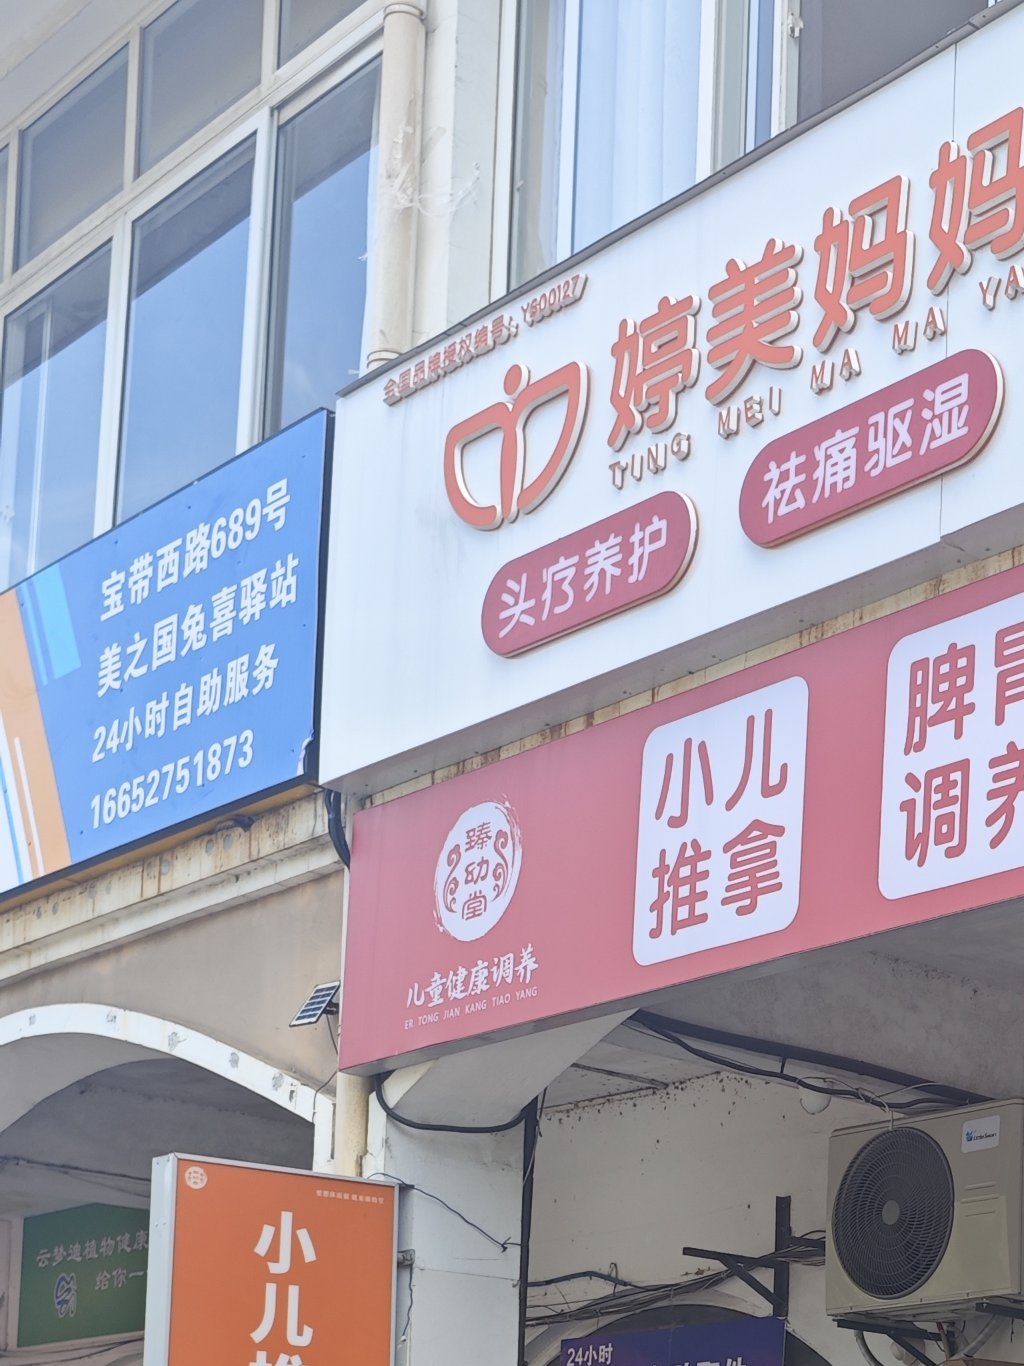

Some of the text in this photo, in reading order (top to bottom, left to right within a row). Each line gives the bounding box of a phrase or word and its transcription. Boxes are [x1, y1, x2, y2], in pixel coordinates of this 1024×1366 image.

[608, 431, 692, 490] TING
[717, 385, 783, 439] MEI
[810, 348, 863, 395] MA
[891, 305, 946, 355] MA
[761, 372, 970, 525] 祛痛驱湿
[100, 478, 291, 624] 宝带西路689号
[498, 514, 669, 640] 头疗养护
[96, 552, 300, 698] 美之国兔喜驿站
[91, 642, 280, 763] 24小时自助服务
[90, 728, 255, 830] 16652751873
[654, 706, 789, 830] 小儿
[648, 818, 787, 941] 推拿
[404, 986, 539, 1030] ER TONG JIAN KANG TIAO YANG
[406, 943, 539, 1009] 儿童健康调养
